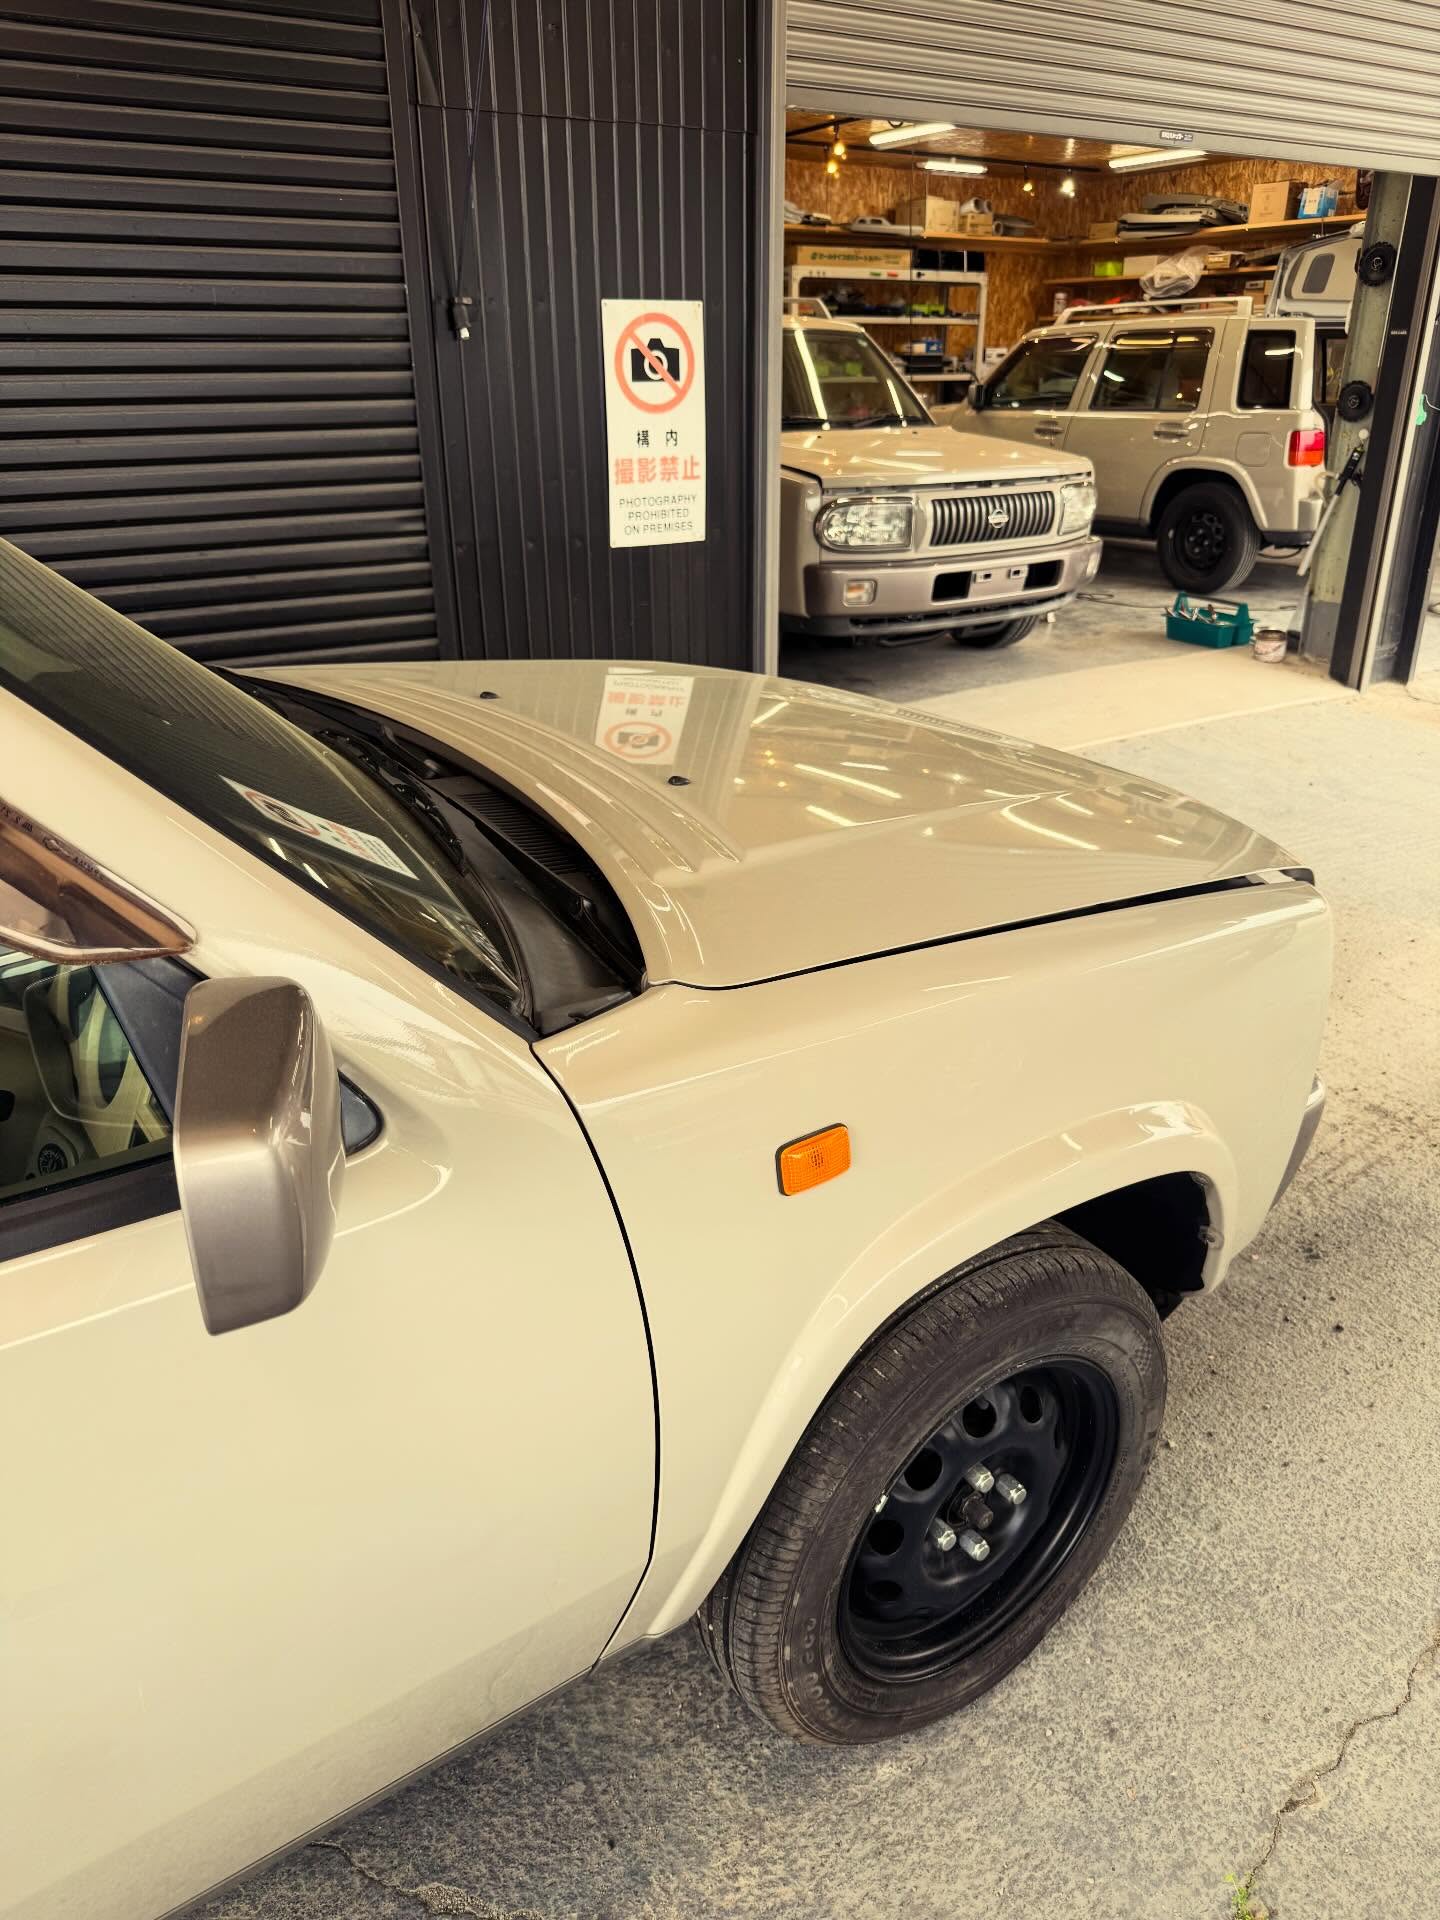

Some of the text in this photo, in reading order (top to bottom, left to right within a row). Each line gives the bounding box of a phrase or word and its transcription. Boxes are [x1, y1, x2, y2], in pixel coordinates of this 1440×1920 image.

[614, 455, 701, 485] 撮影禁止
[619, 494, 697, 508] PHOTOGRAPHY
[628, 508, 689, 521] PROHIBITED
[624, 520, 694, 536] ON PREMISES
